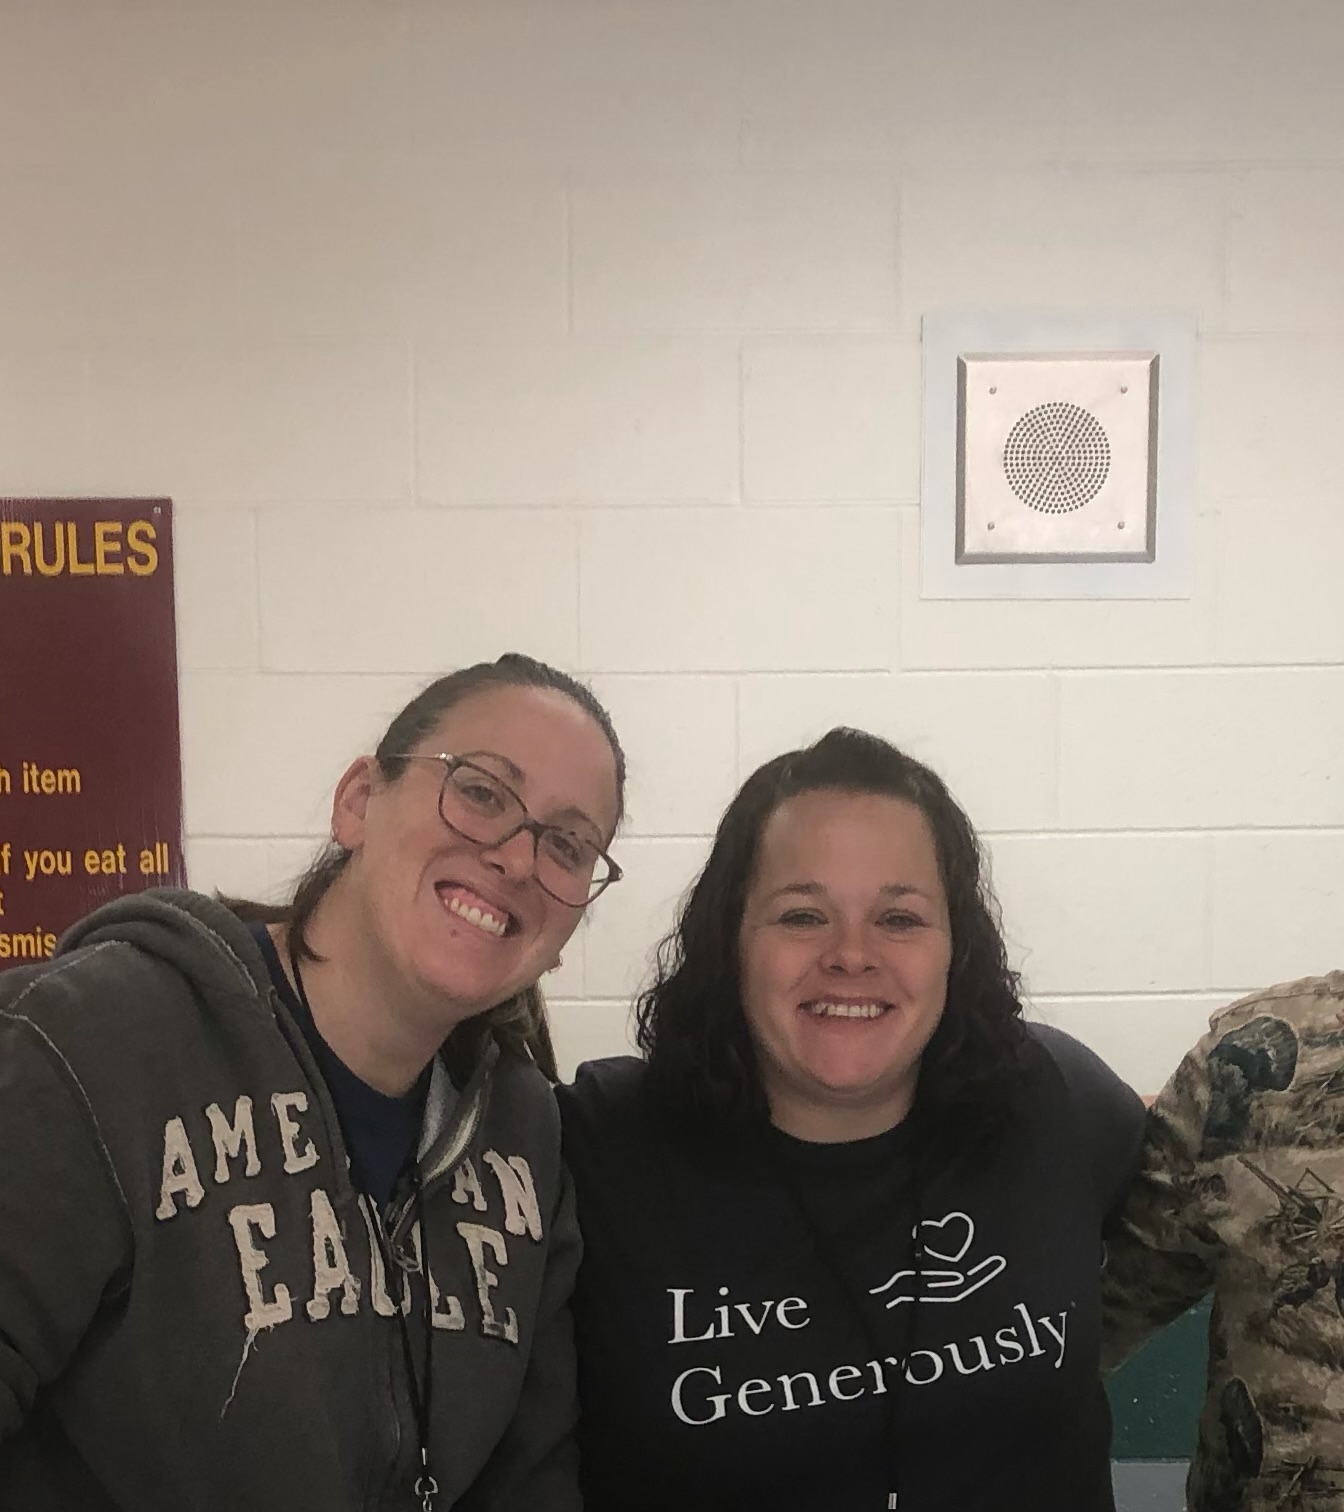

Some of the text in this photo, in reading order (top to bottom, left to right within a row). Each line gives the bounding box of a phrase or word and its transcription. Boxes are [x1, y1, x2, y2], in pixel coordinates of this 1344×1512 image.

[0, 518, 159, 577] RULES
[22, 761, 81, 795] item
[23, 850, 72, 881] you
[84, 842, 127, 876] eat
[139, 840, 169, 875] all
[665, 1285, 811, 1344] Live
[670, 1302, 1070, 1426] Generously
